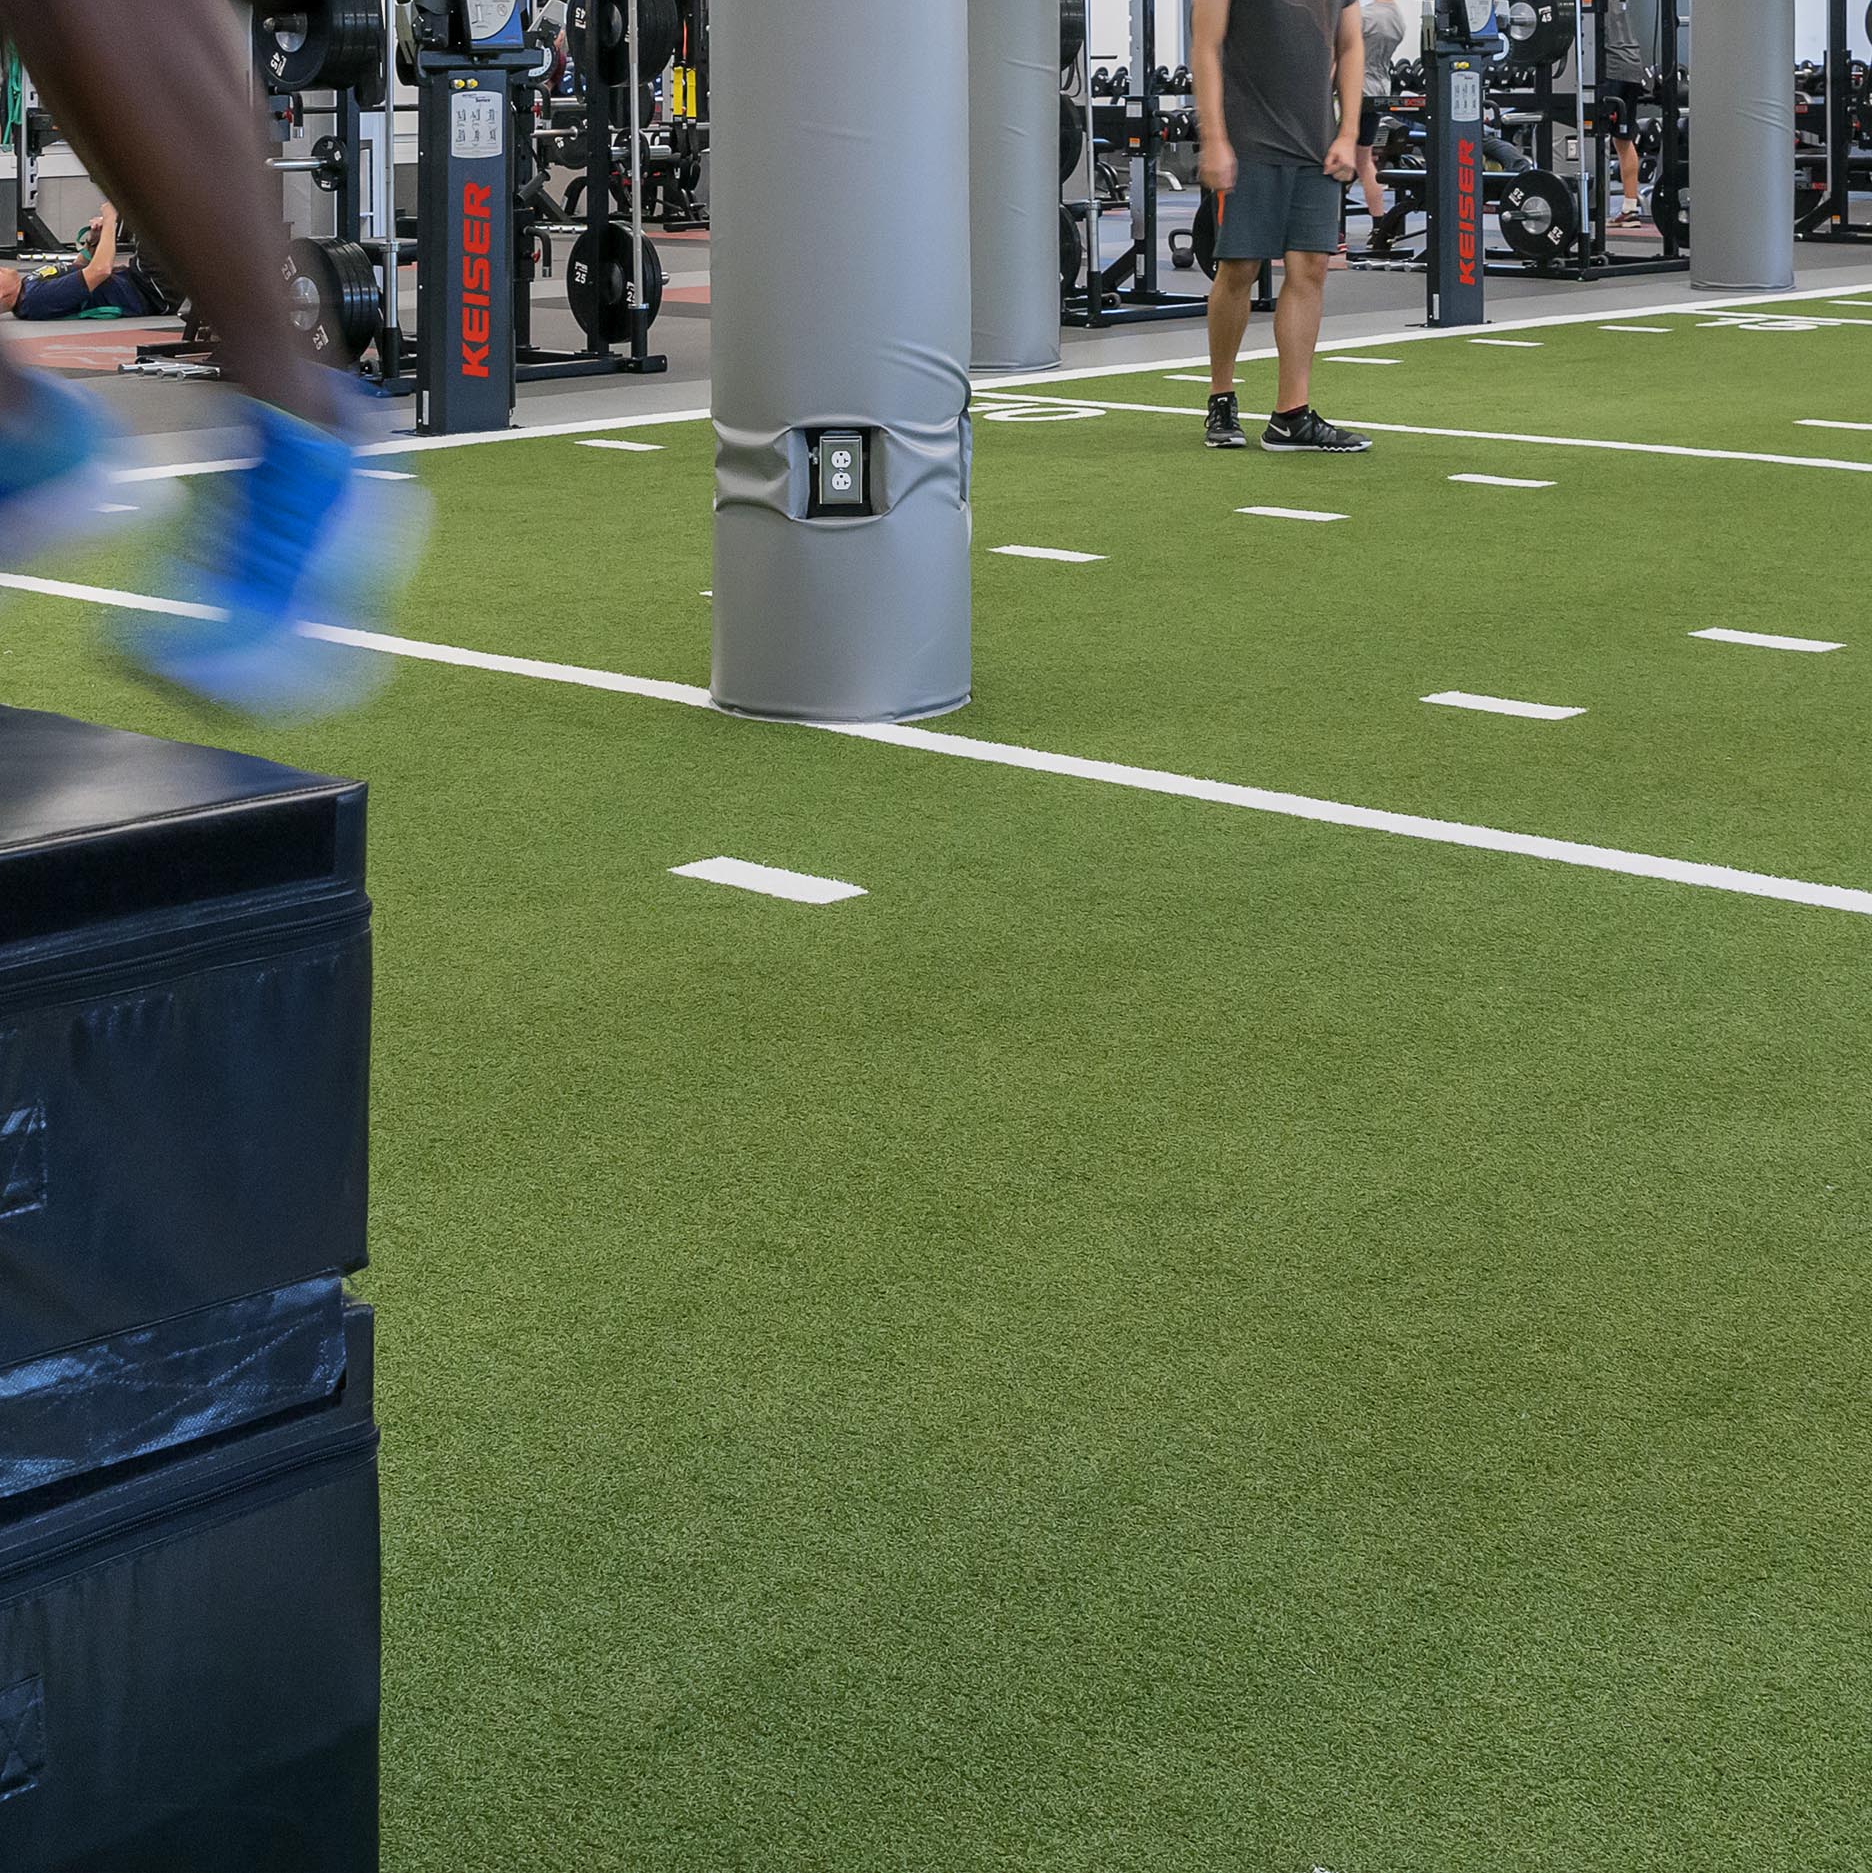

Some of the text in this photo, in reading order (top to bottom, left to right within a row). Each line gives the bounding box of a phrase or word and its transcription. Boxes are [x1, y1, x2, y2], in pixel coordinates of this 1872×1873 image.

[461, 182, 491, 379] KEISER
[575, 271, 587, 284] 25
[1458, 138, 1475, 287] KEISER
